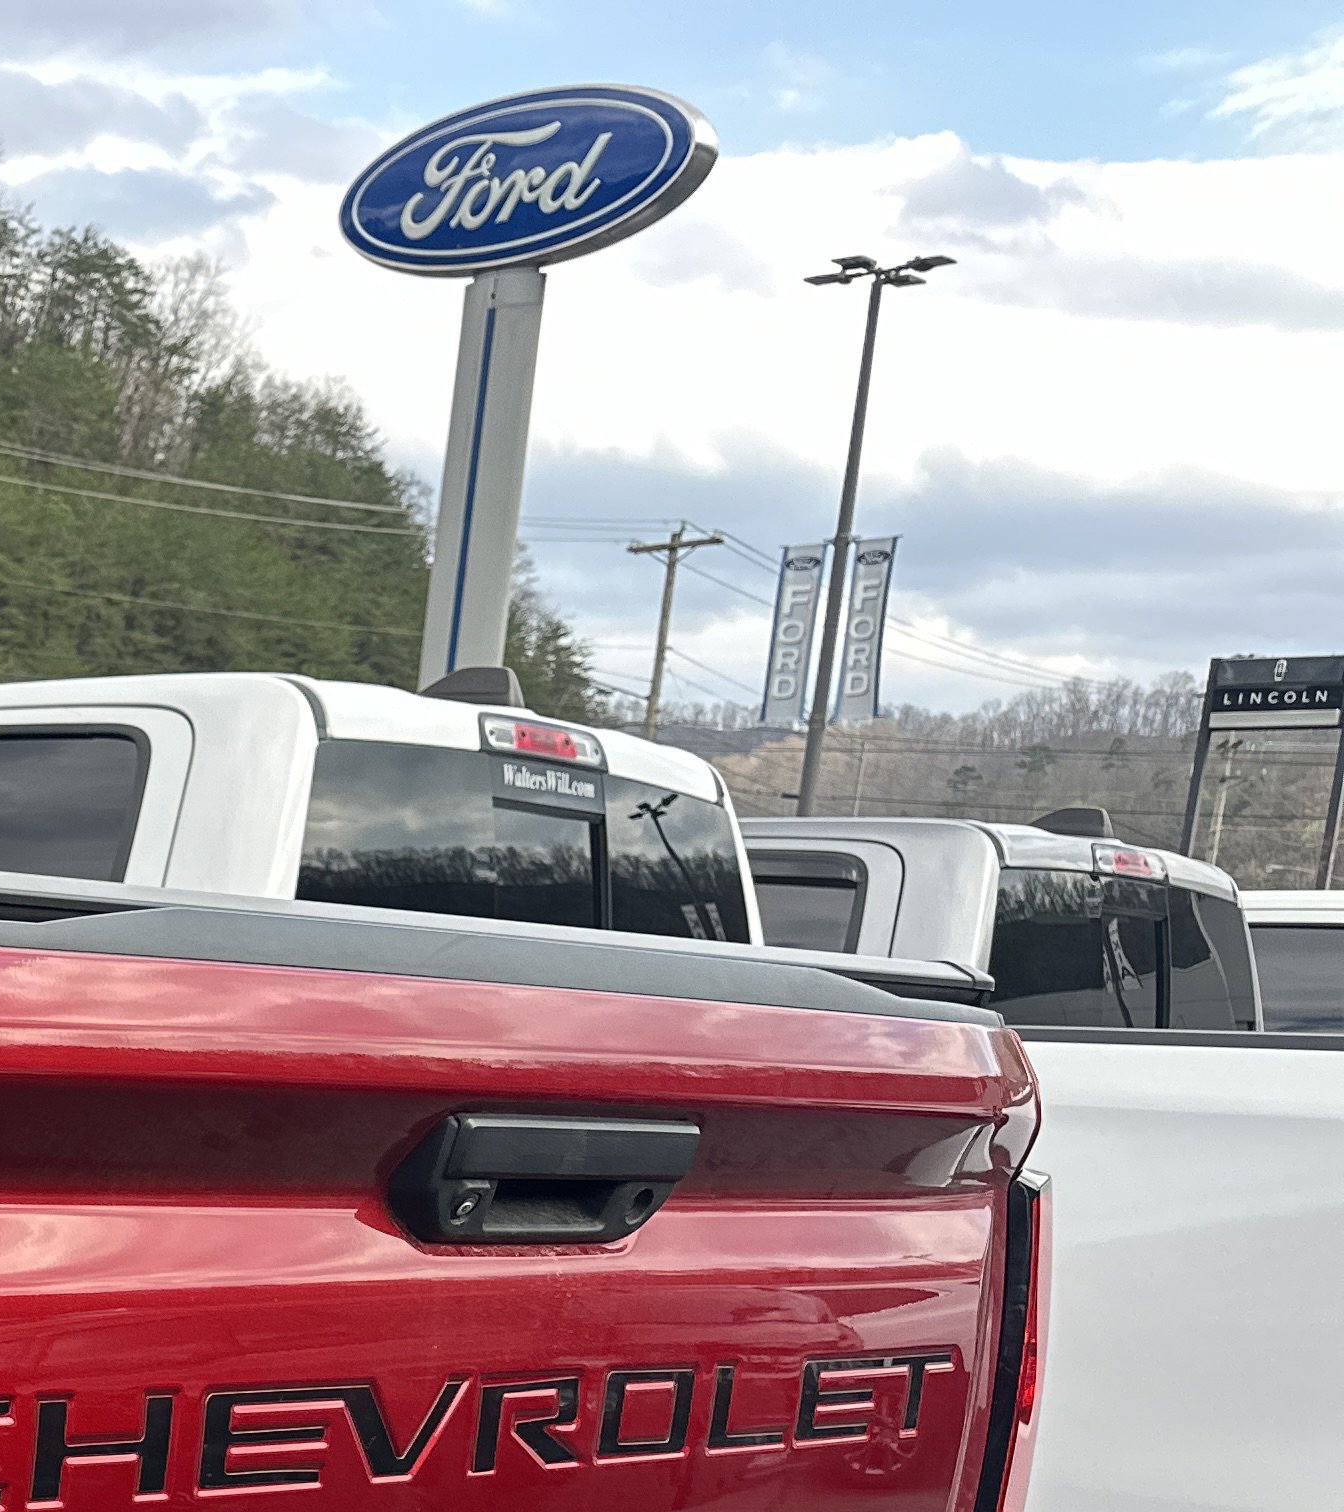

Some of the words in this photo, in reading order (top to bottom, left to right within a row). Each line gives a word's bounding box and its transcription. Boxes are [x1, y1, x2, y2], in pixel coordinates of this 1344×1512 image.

[399, 120, 613, 241] Ford
[772, 584, 813, 700] FORD
[844, 579, 882, 697] FORD
[1223, 689, 1328, 706] LINCOLN
